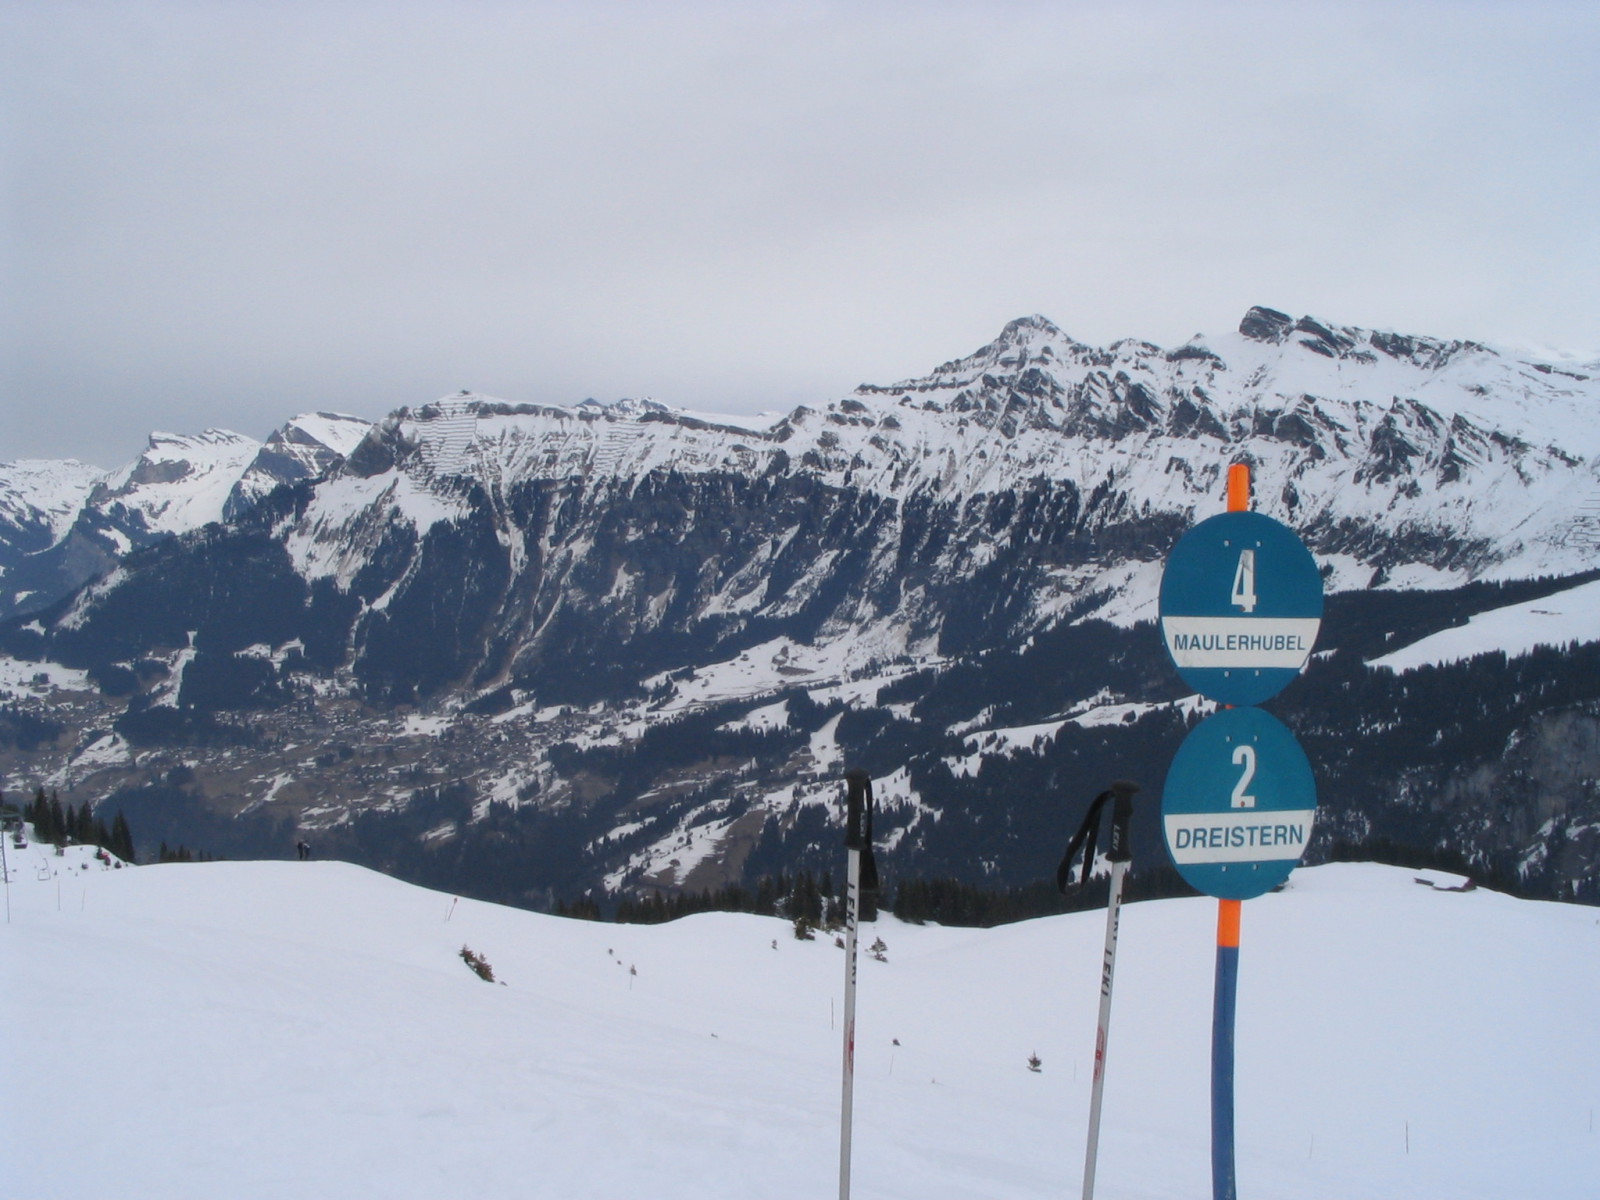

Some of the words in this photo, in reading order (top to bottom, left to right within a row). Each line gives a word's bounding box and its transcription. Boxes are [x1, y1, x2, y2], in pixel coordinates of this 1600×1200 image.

[1231, 549, 1257, 613] 4
[1174, 634, 1306, 651] MAULERHUBEL
[1230, 745, 1256, 808] 2
[1175, 824, 1304, 849] DREISTERN
[1100, 948, 1113, 998] LEKI
